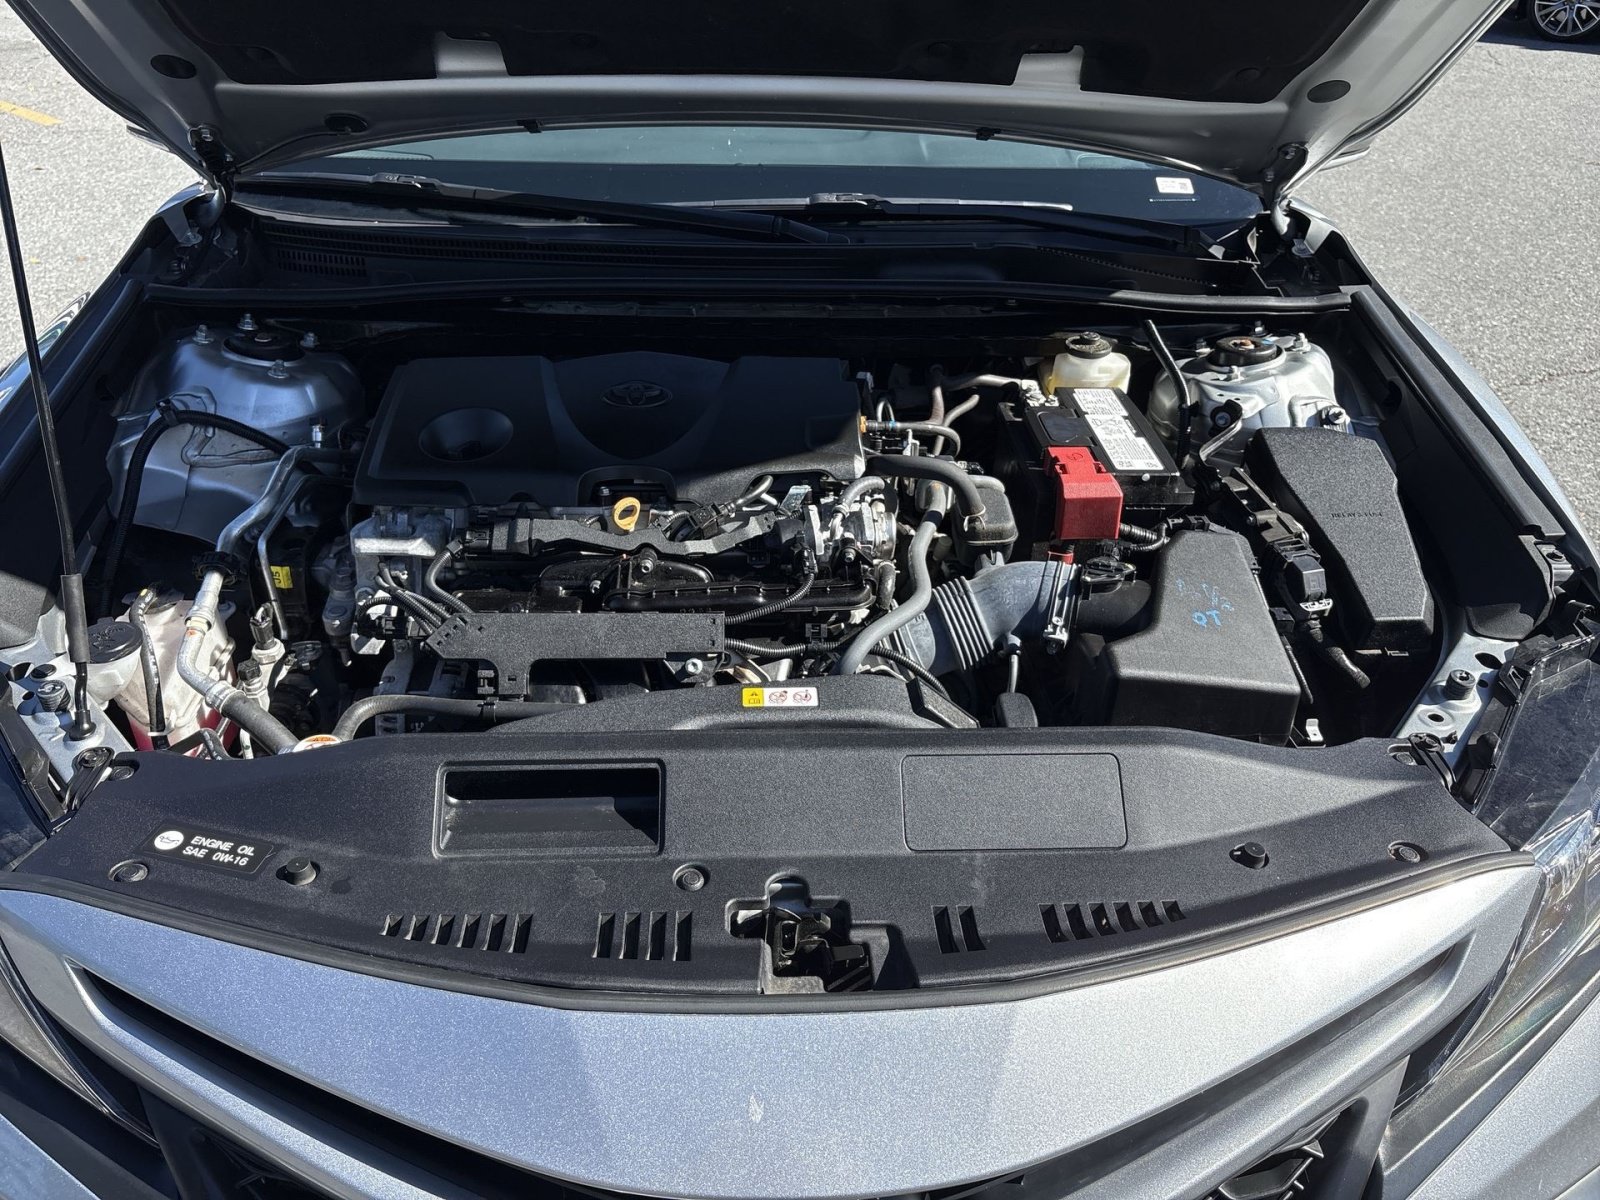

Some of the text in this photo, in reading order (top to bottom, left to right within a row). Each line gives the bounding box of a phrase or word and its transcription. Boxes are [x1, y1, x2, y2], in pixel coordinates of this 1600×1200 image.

[182, 845, 250, 866] SAE 0W-16
[190, 835, 255, 857] ENGINE OIL
